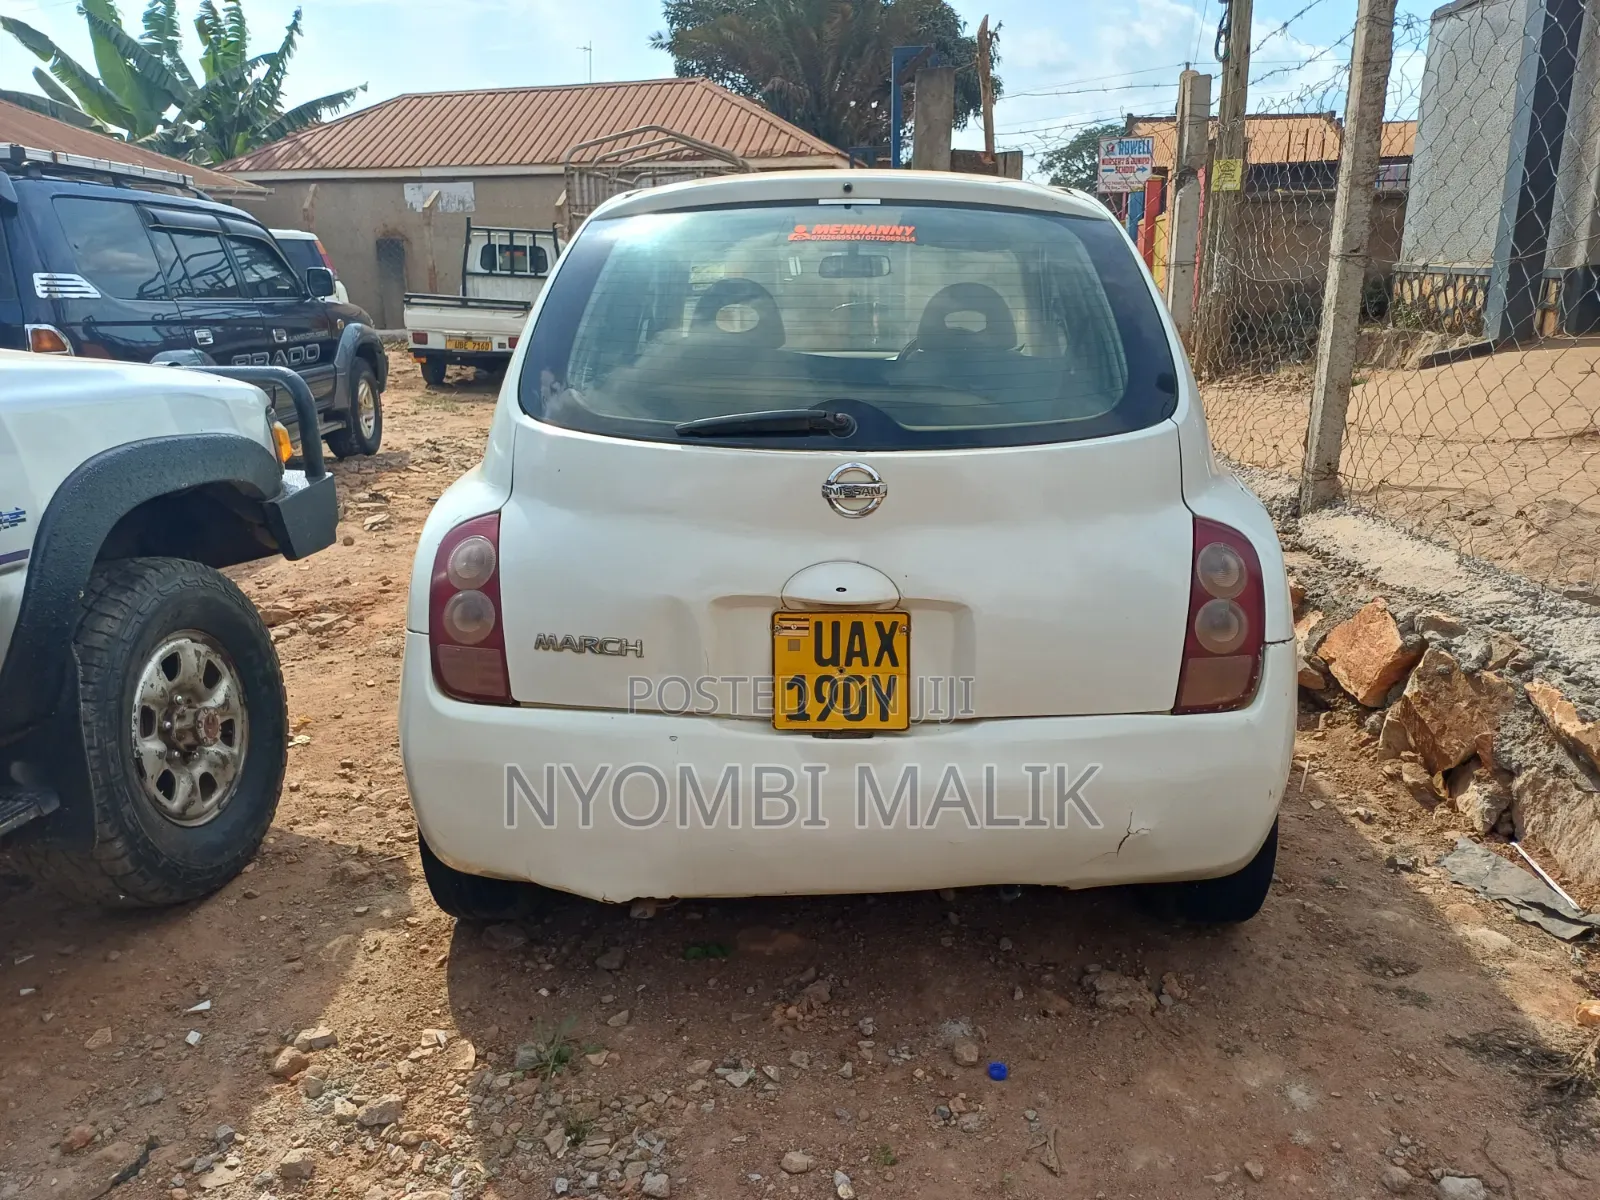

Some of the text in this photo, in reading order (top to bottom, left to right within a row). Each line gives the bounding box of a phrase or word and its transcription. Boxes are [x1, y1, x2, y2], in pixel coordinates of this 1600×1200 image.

[1118, 139, 1151, 155] ROWELL
[1115, 165, 1136, 174] SCHOOL
[811, 224, 915, 235] MENHANNY
[231, 344, 320, 366] PRADO
[827, 485, 881, 496] NISSAN
[533, 633, 644, 658] MARCH
[814, 620, 900, 667] UAX
[786, 674, 898, 722] 190Y
